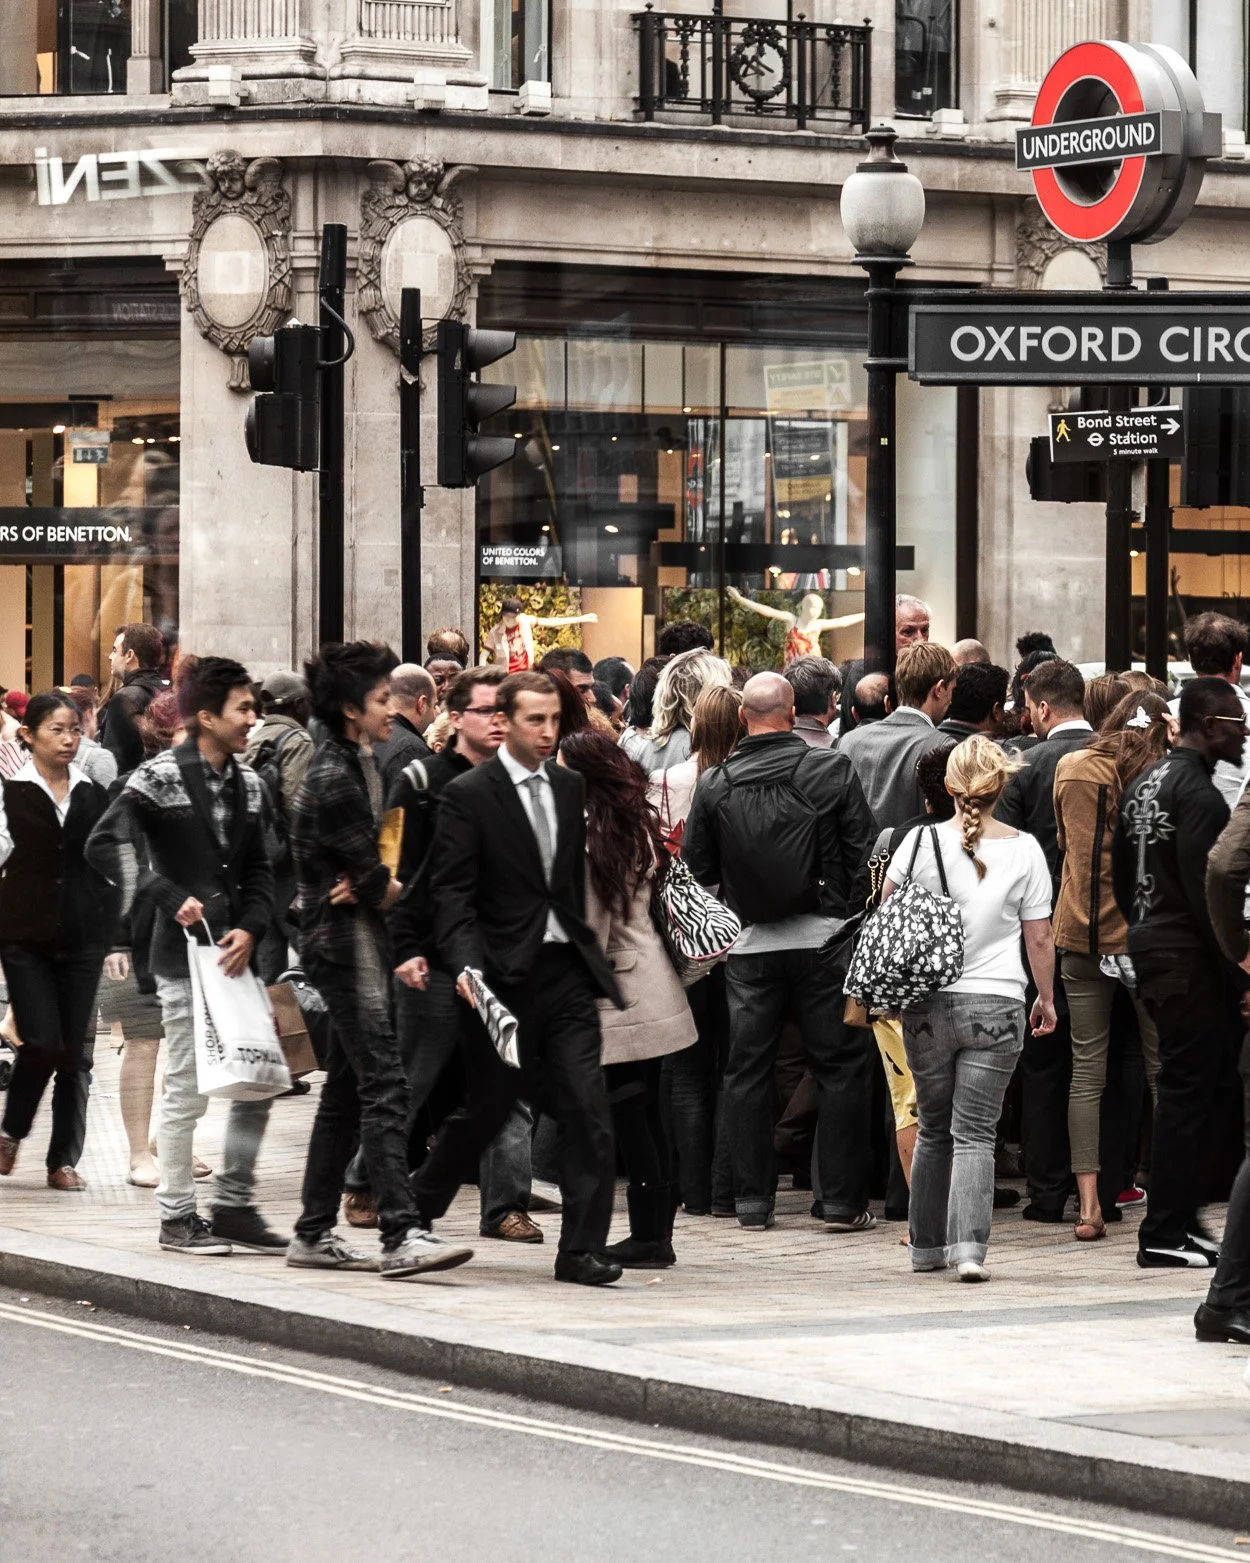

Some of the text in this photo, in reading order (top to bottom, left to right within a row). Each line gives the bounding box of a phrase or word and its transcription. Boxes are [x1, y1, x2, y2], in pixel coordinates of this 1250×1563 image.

[1022, 122, 1155, 160] UNDERGROUND
[950, 325, 1142, 362] OXFORD
[1077, 415, 1158, 429] Bond Street
[1109, 432, 1158, 445] Station
[22, 526, 44, 542] OF
[47, 526, 132, 542] BENETTON.
[482, 547, 546, 557] UNITED COLORS
[482, 557, 538, 566] OF BENETTON.
[205, 1030, 218, 1066] SHOP
